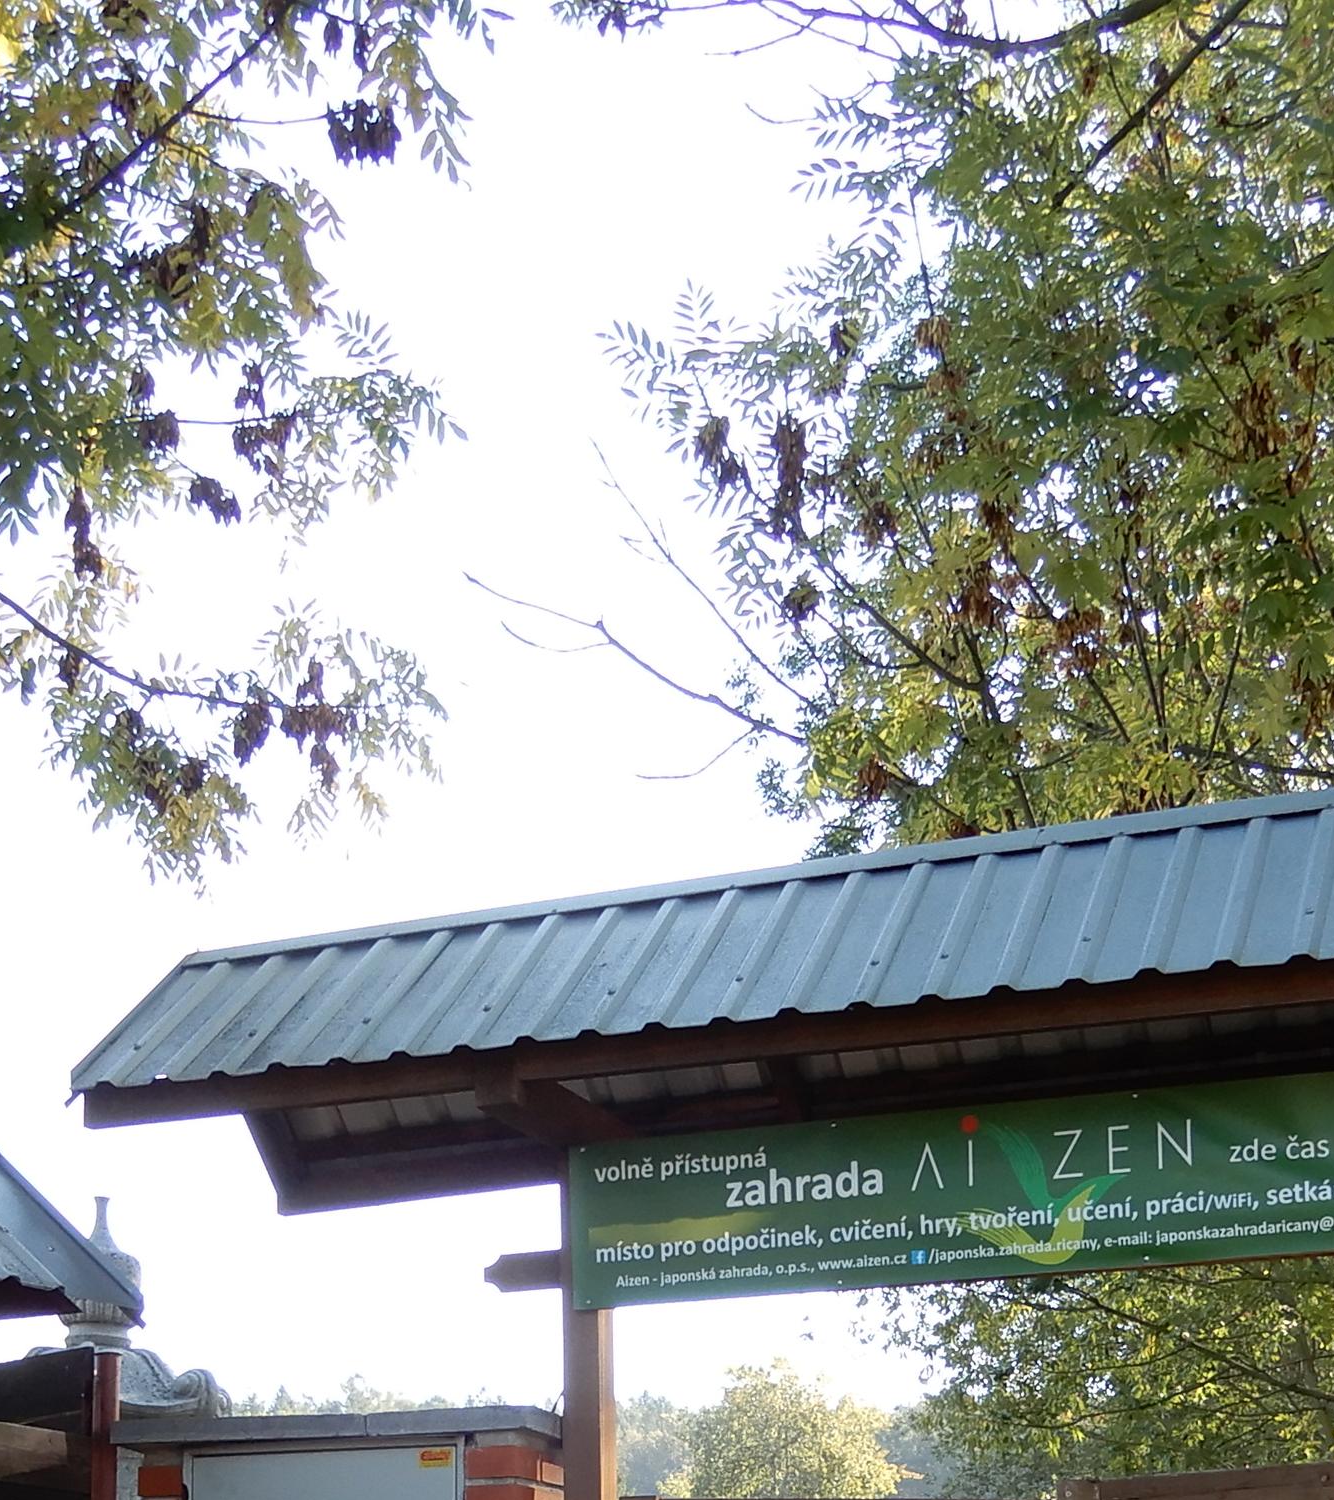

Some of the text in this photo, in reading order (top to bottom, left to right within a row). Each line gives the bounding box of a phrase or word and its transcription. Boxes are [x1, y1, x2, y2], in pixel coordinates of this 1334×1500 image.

[594, 1146, 767, 1183] volně přístupná
[725, 1160, 884, 1208] zahrada
[1229, 1138, 1277, 1163] zde
[1285, 1134, 1330, 1160] čas
[595, 1240, 655, 1263] místo
[660, 1238, 697, 1262] pro
[702, 1224, 823, 1256] odpočinek,
[830, 1215, 914, 1243] cvičení,
[920, 1213, 963, 1238] hry,
[969, 1203, 1060, 1231] tvoření,
[1067, 1195, 1139, 1223] učení,
[615, 1274, 650, 1288] Aizen
[660, 1266, 716, 1287] japonská
[719, 1262, 773, 1279] zahrada,
[818, 1253, 907, 1271] www.aizen.cz
[1104, 1231, 1153, 1248] e-mail:
